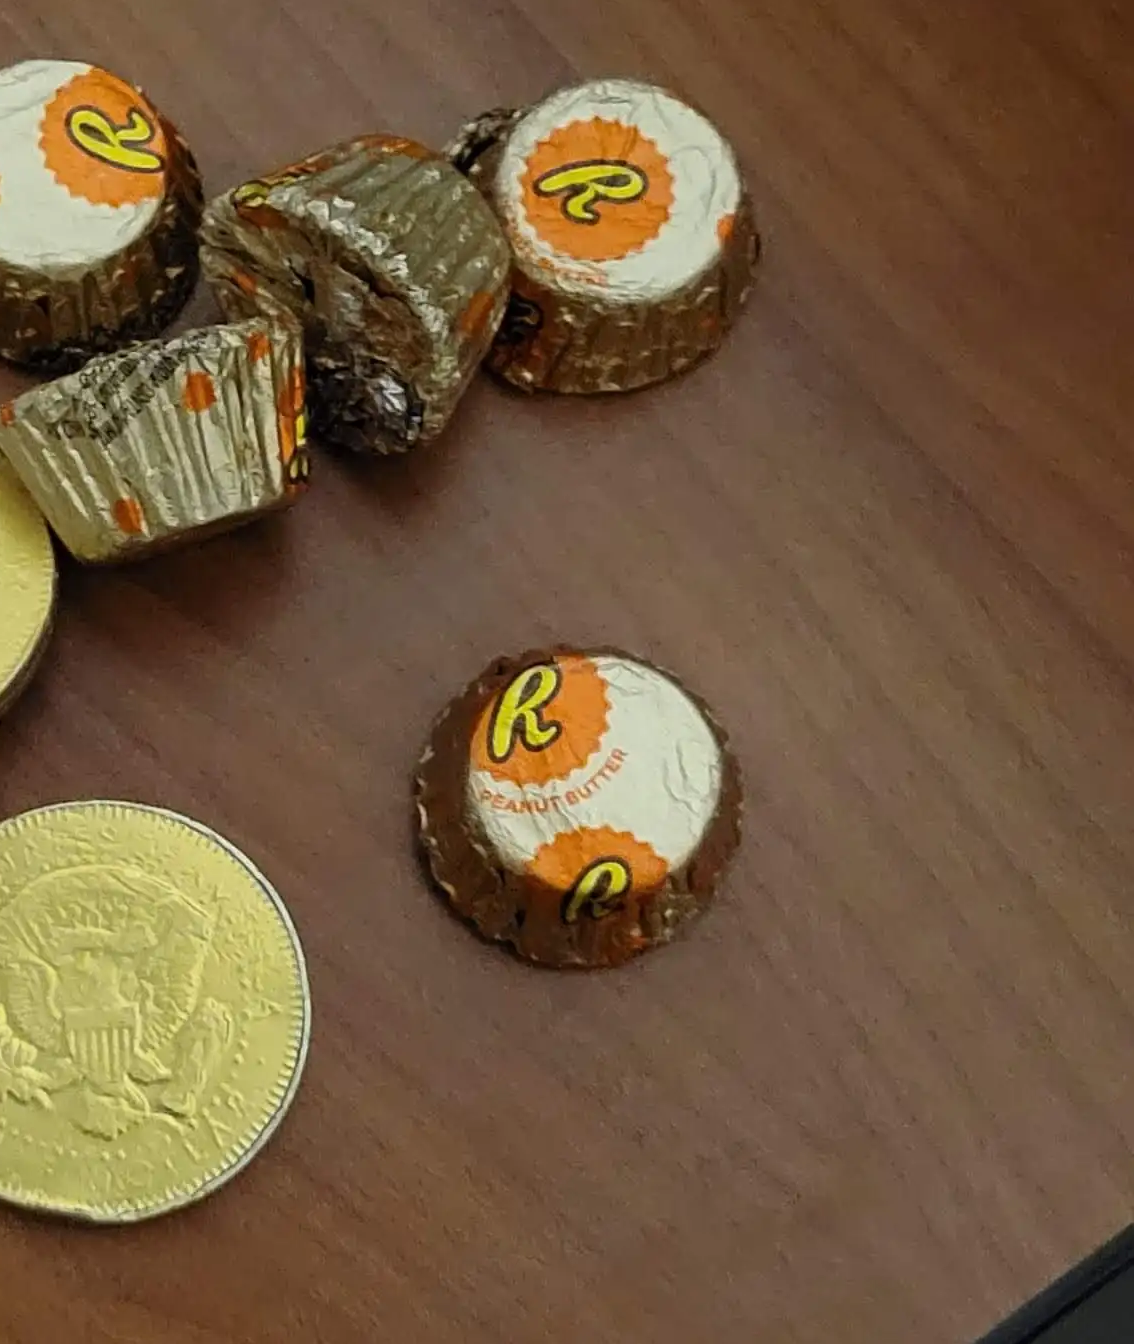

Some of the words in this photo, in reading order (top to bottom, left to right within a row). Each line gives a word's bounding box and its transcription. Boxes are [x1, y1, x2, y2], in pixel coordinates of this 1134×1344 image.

[66, 104, 165, 172] R
[532, 159, 648, 225] R
[487, 663, 561, 763] R
[482, 788, 560, 813] PEANUT
[566, 748, 628, 805] BUTTER
